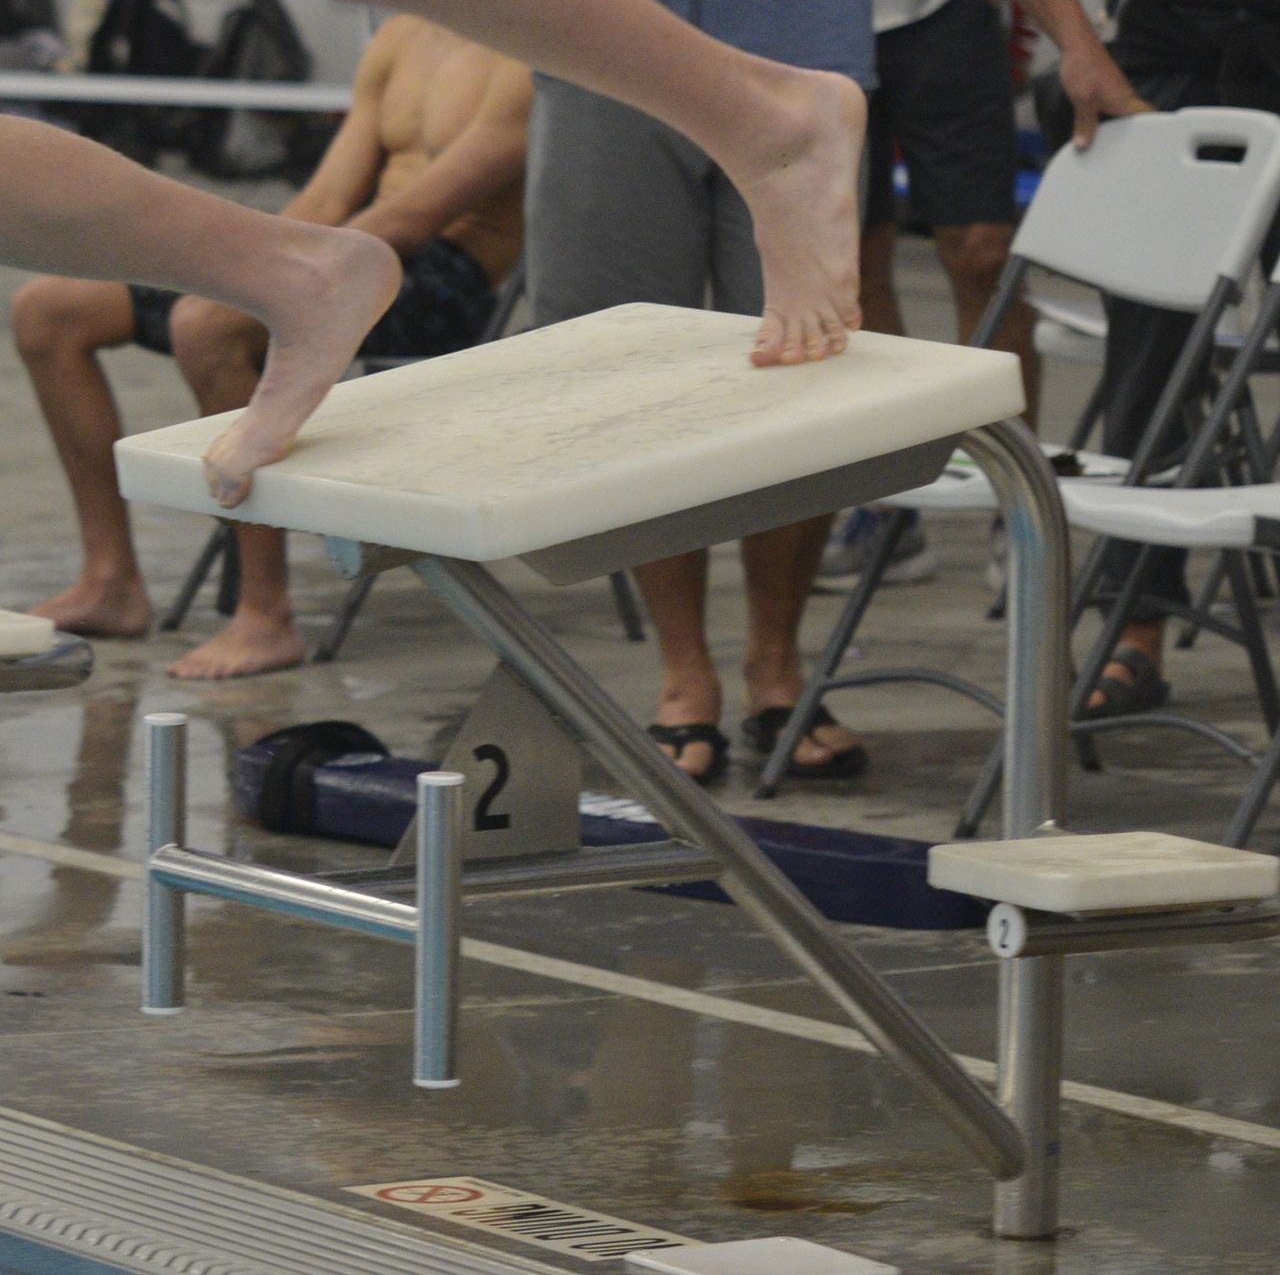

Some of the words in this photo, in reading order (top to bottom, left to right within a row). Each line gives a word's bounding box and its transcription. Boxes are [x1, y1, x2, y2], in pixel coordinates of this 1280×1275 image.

[473, 743, 510, 832] 2
[999, 918, 1010, 950] 2
[450, 1203, 637, 1241] DIVING
